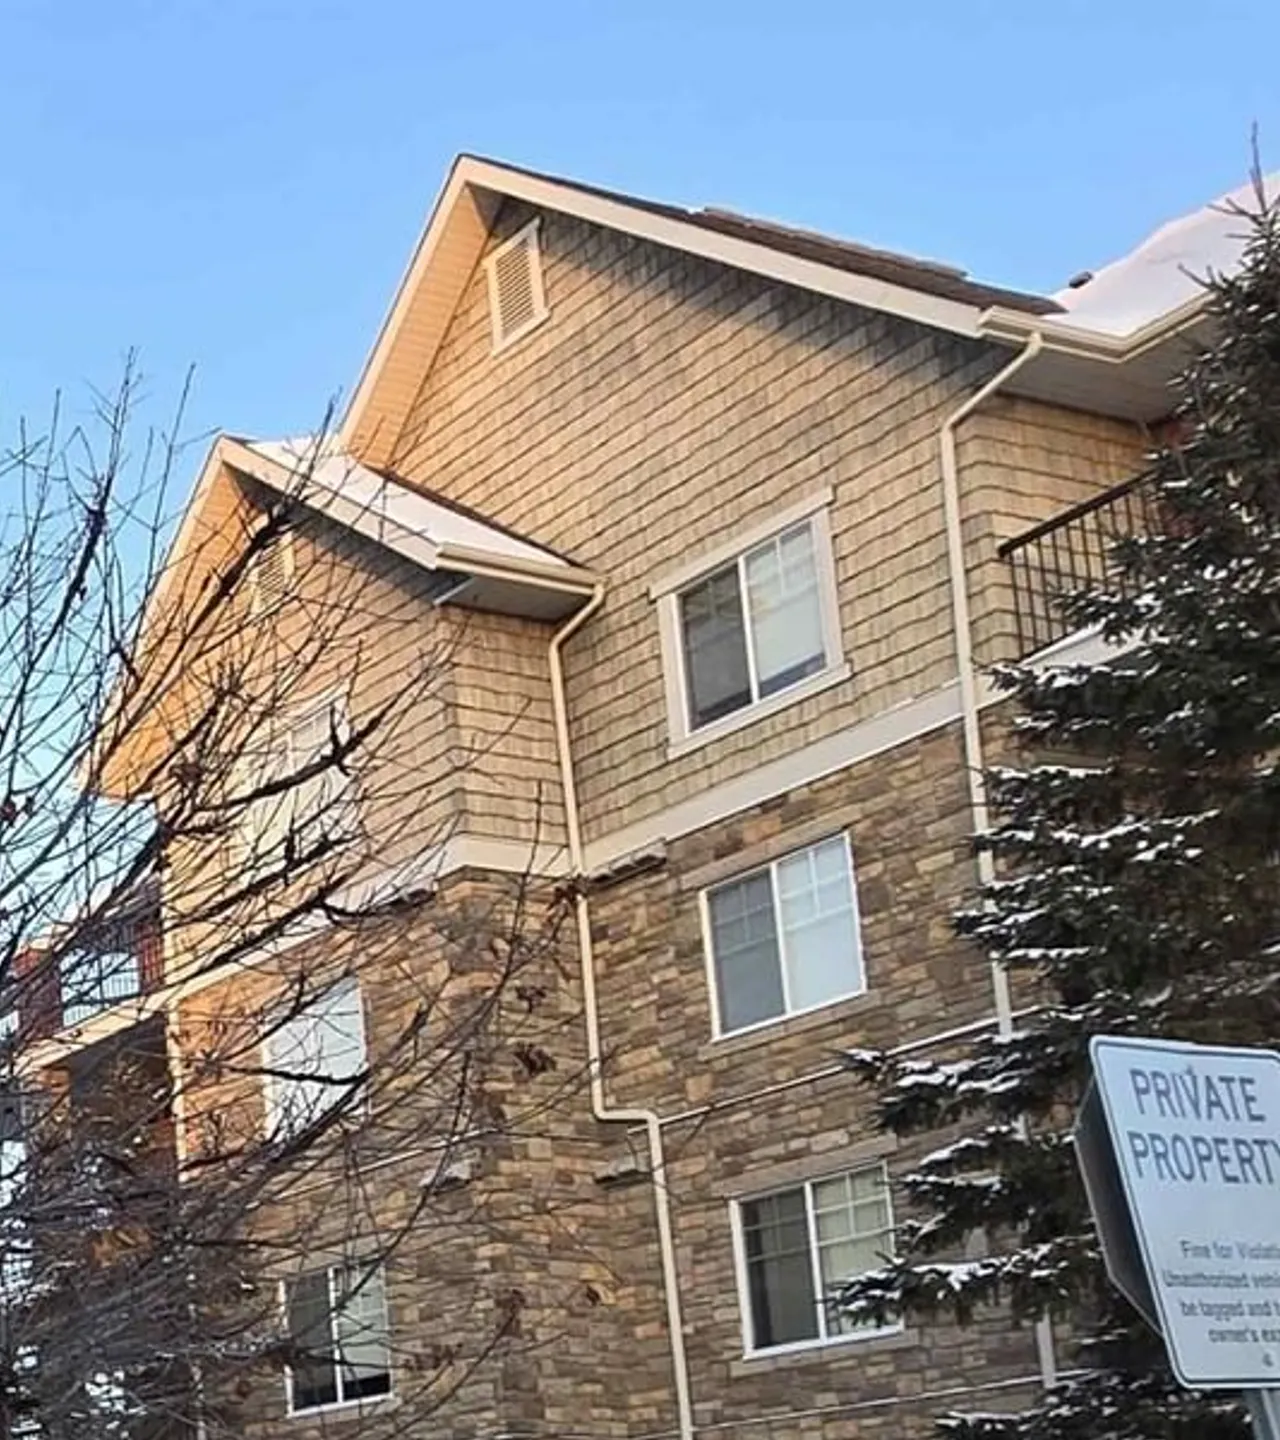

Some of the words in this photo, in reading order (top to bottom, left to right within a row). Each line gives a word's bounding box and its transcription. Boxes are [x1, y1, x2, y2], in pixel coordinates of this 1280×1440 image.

[1129, 1068, 1266, 1121] PRIVATE
[1199, 1300, 1245, 1321] tagged
[1247, 1301, 1272, 1316] and
